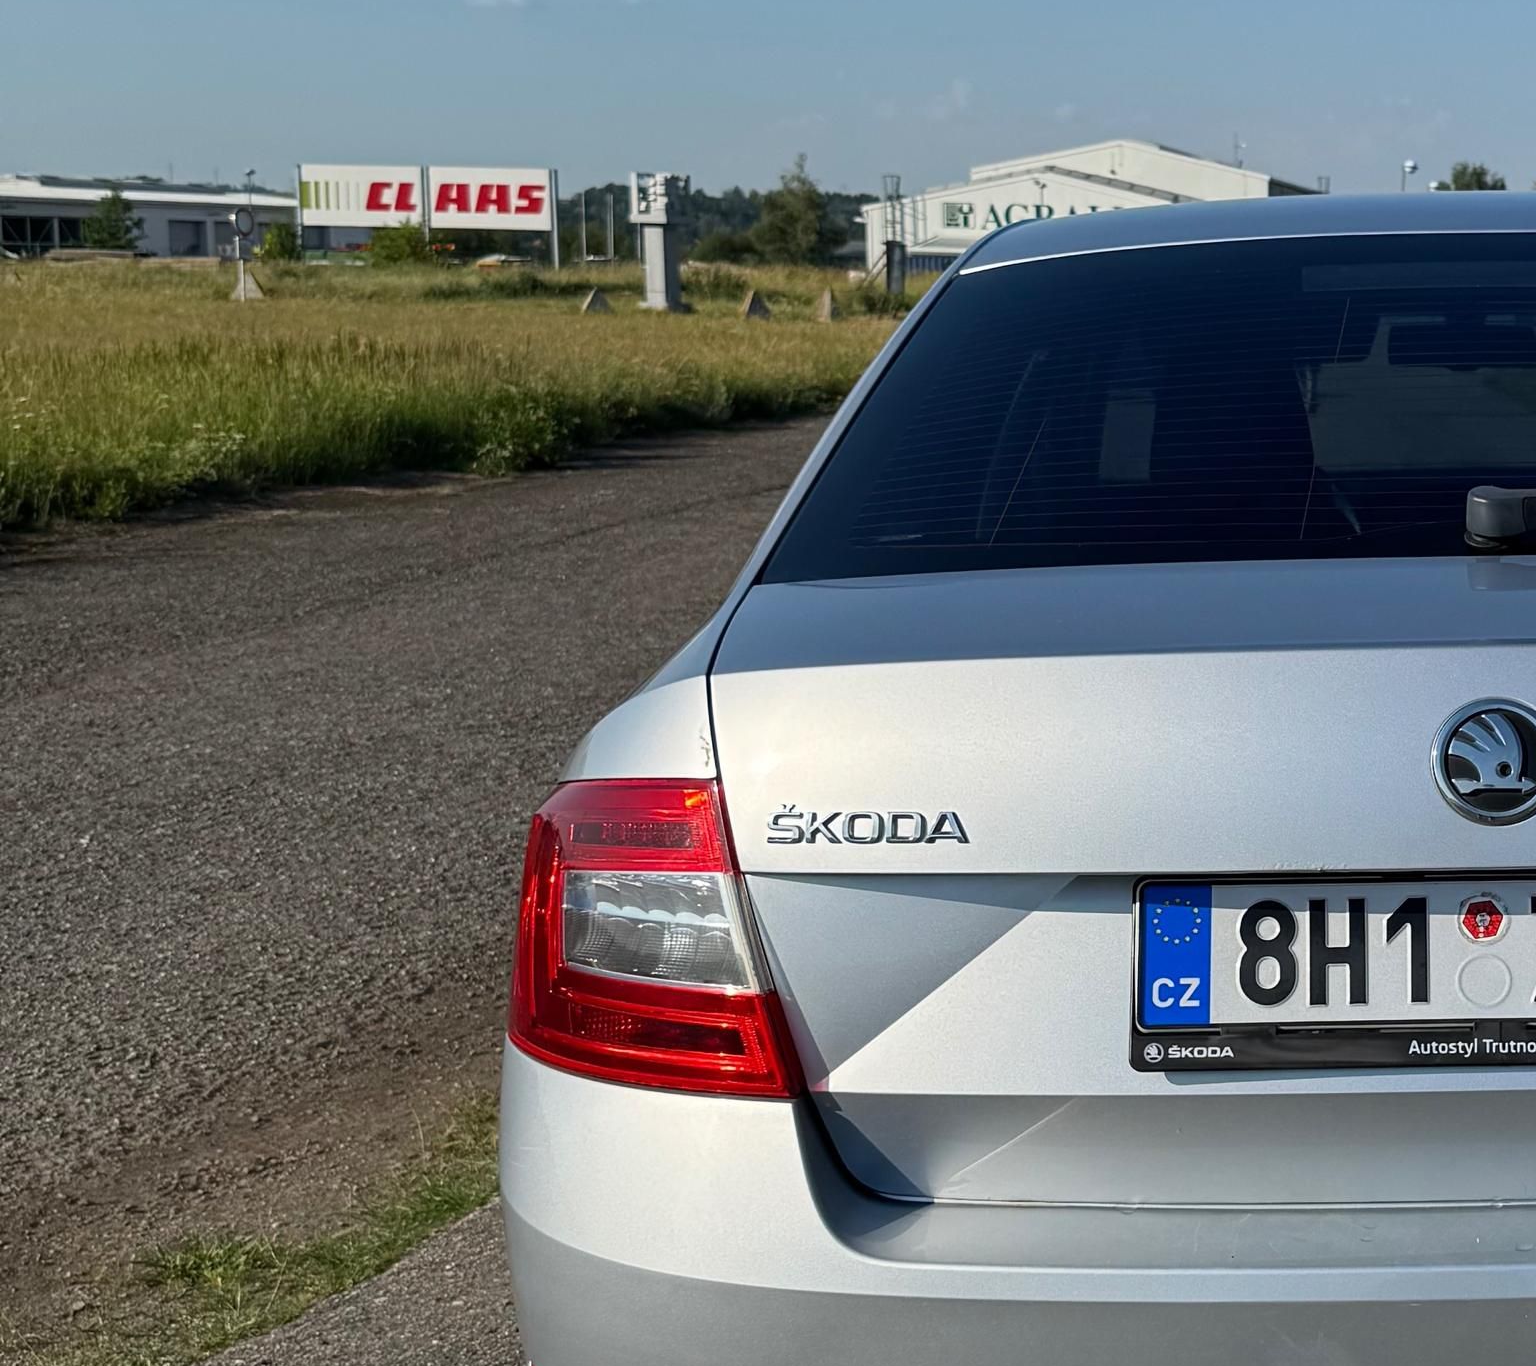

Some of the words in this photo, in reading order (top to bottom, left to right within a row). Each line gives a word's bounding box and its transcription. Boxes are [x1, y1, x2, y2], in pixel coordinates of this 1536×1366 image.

[767, 803, 970, 844] ŠKODA
[1236, 897, 1431, 1007] 8H1
[1151, 977, 1200, 1009] CZ
[1168, 1044, 1235, 1059] ŠKODA
[1408, 1037, 1478, 1057] Autostyl
